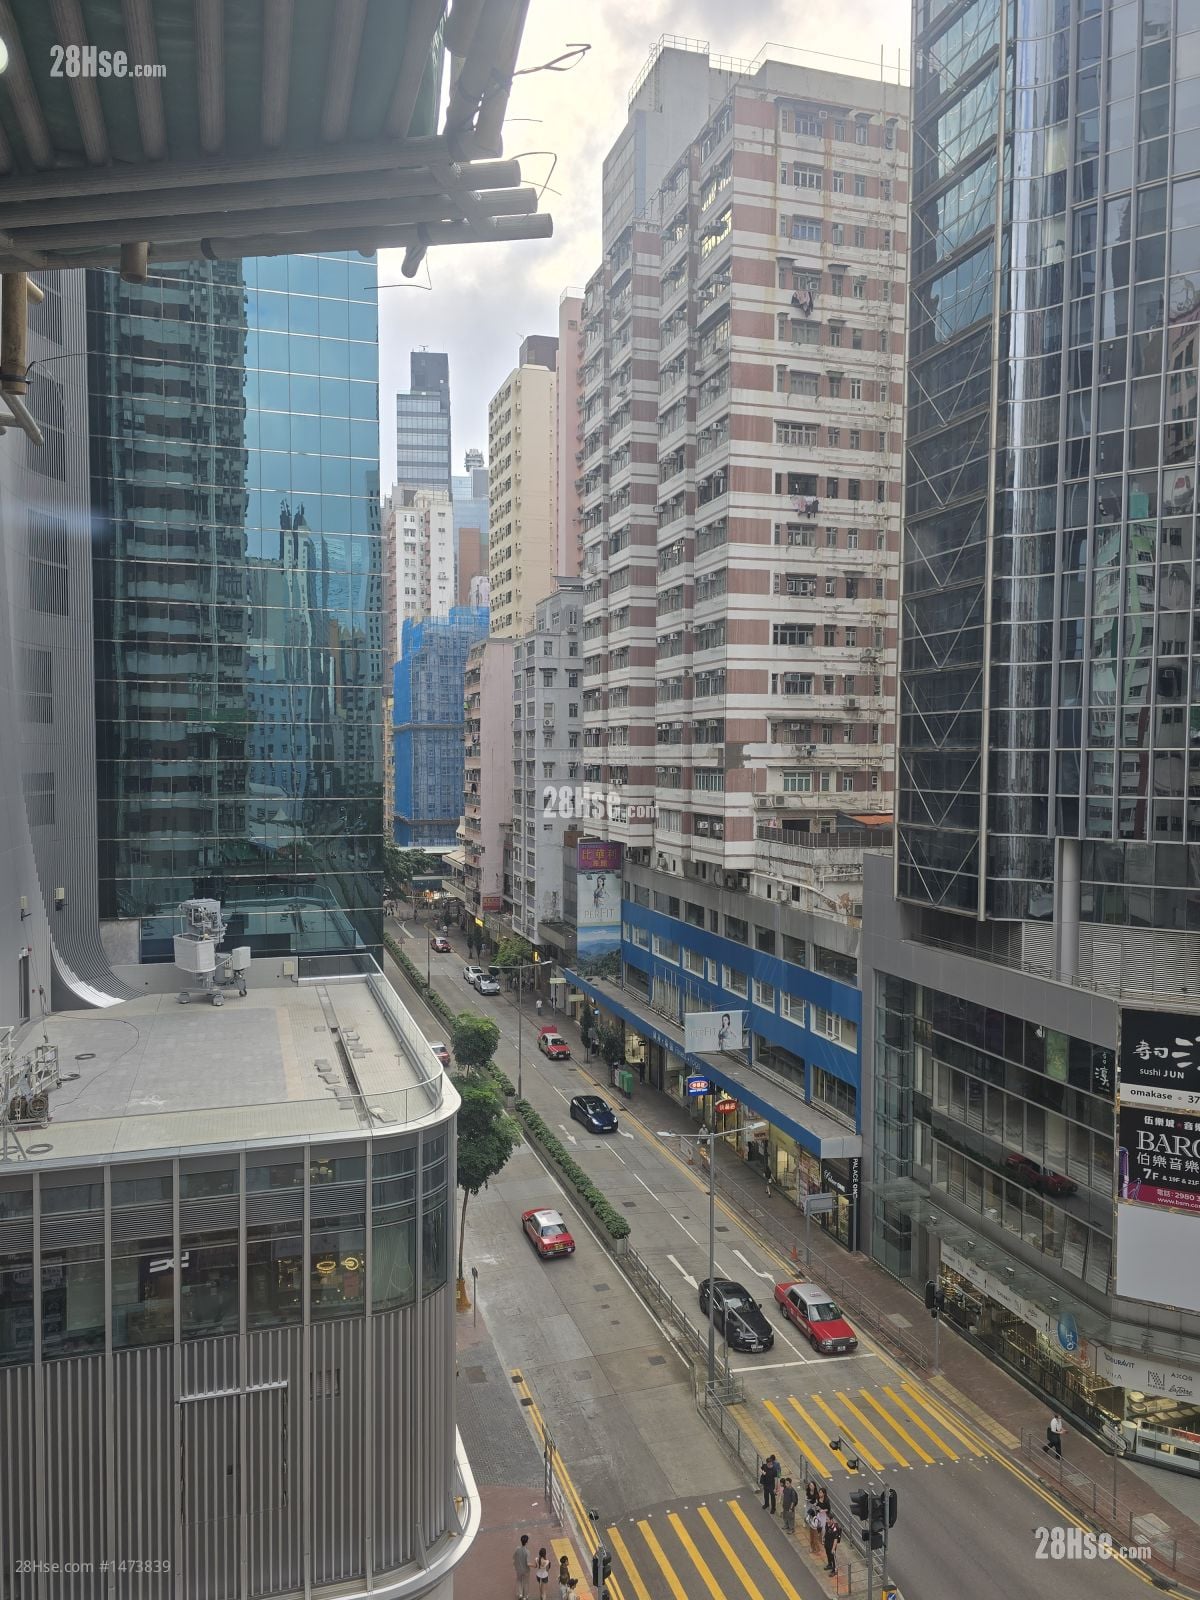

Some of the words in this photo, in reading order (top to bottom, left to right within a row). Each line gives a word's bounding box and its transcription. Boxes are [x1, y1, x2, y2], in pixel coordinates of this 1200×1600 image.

[1140, 1067, 1161, 1077] sushi
[1163, 1070, 1185, 1079] JUN
[1130, 1089, 1173, 1100] omakase
